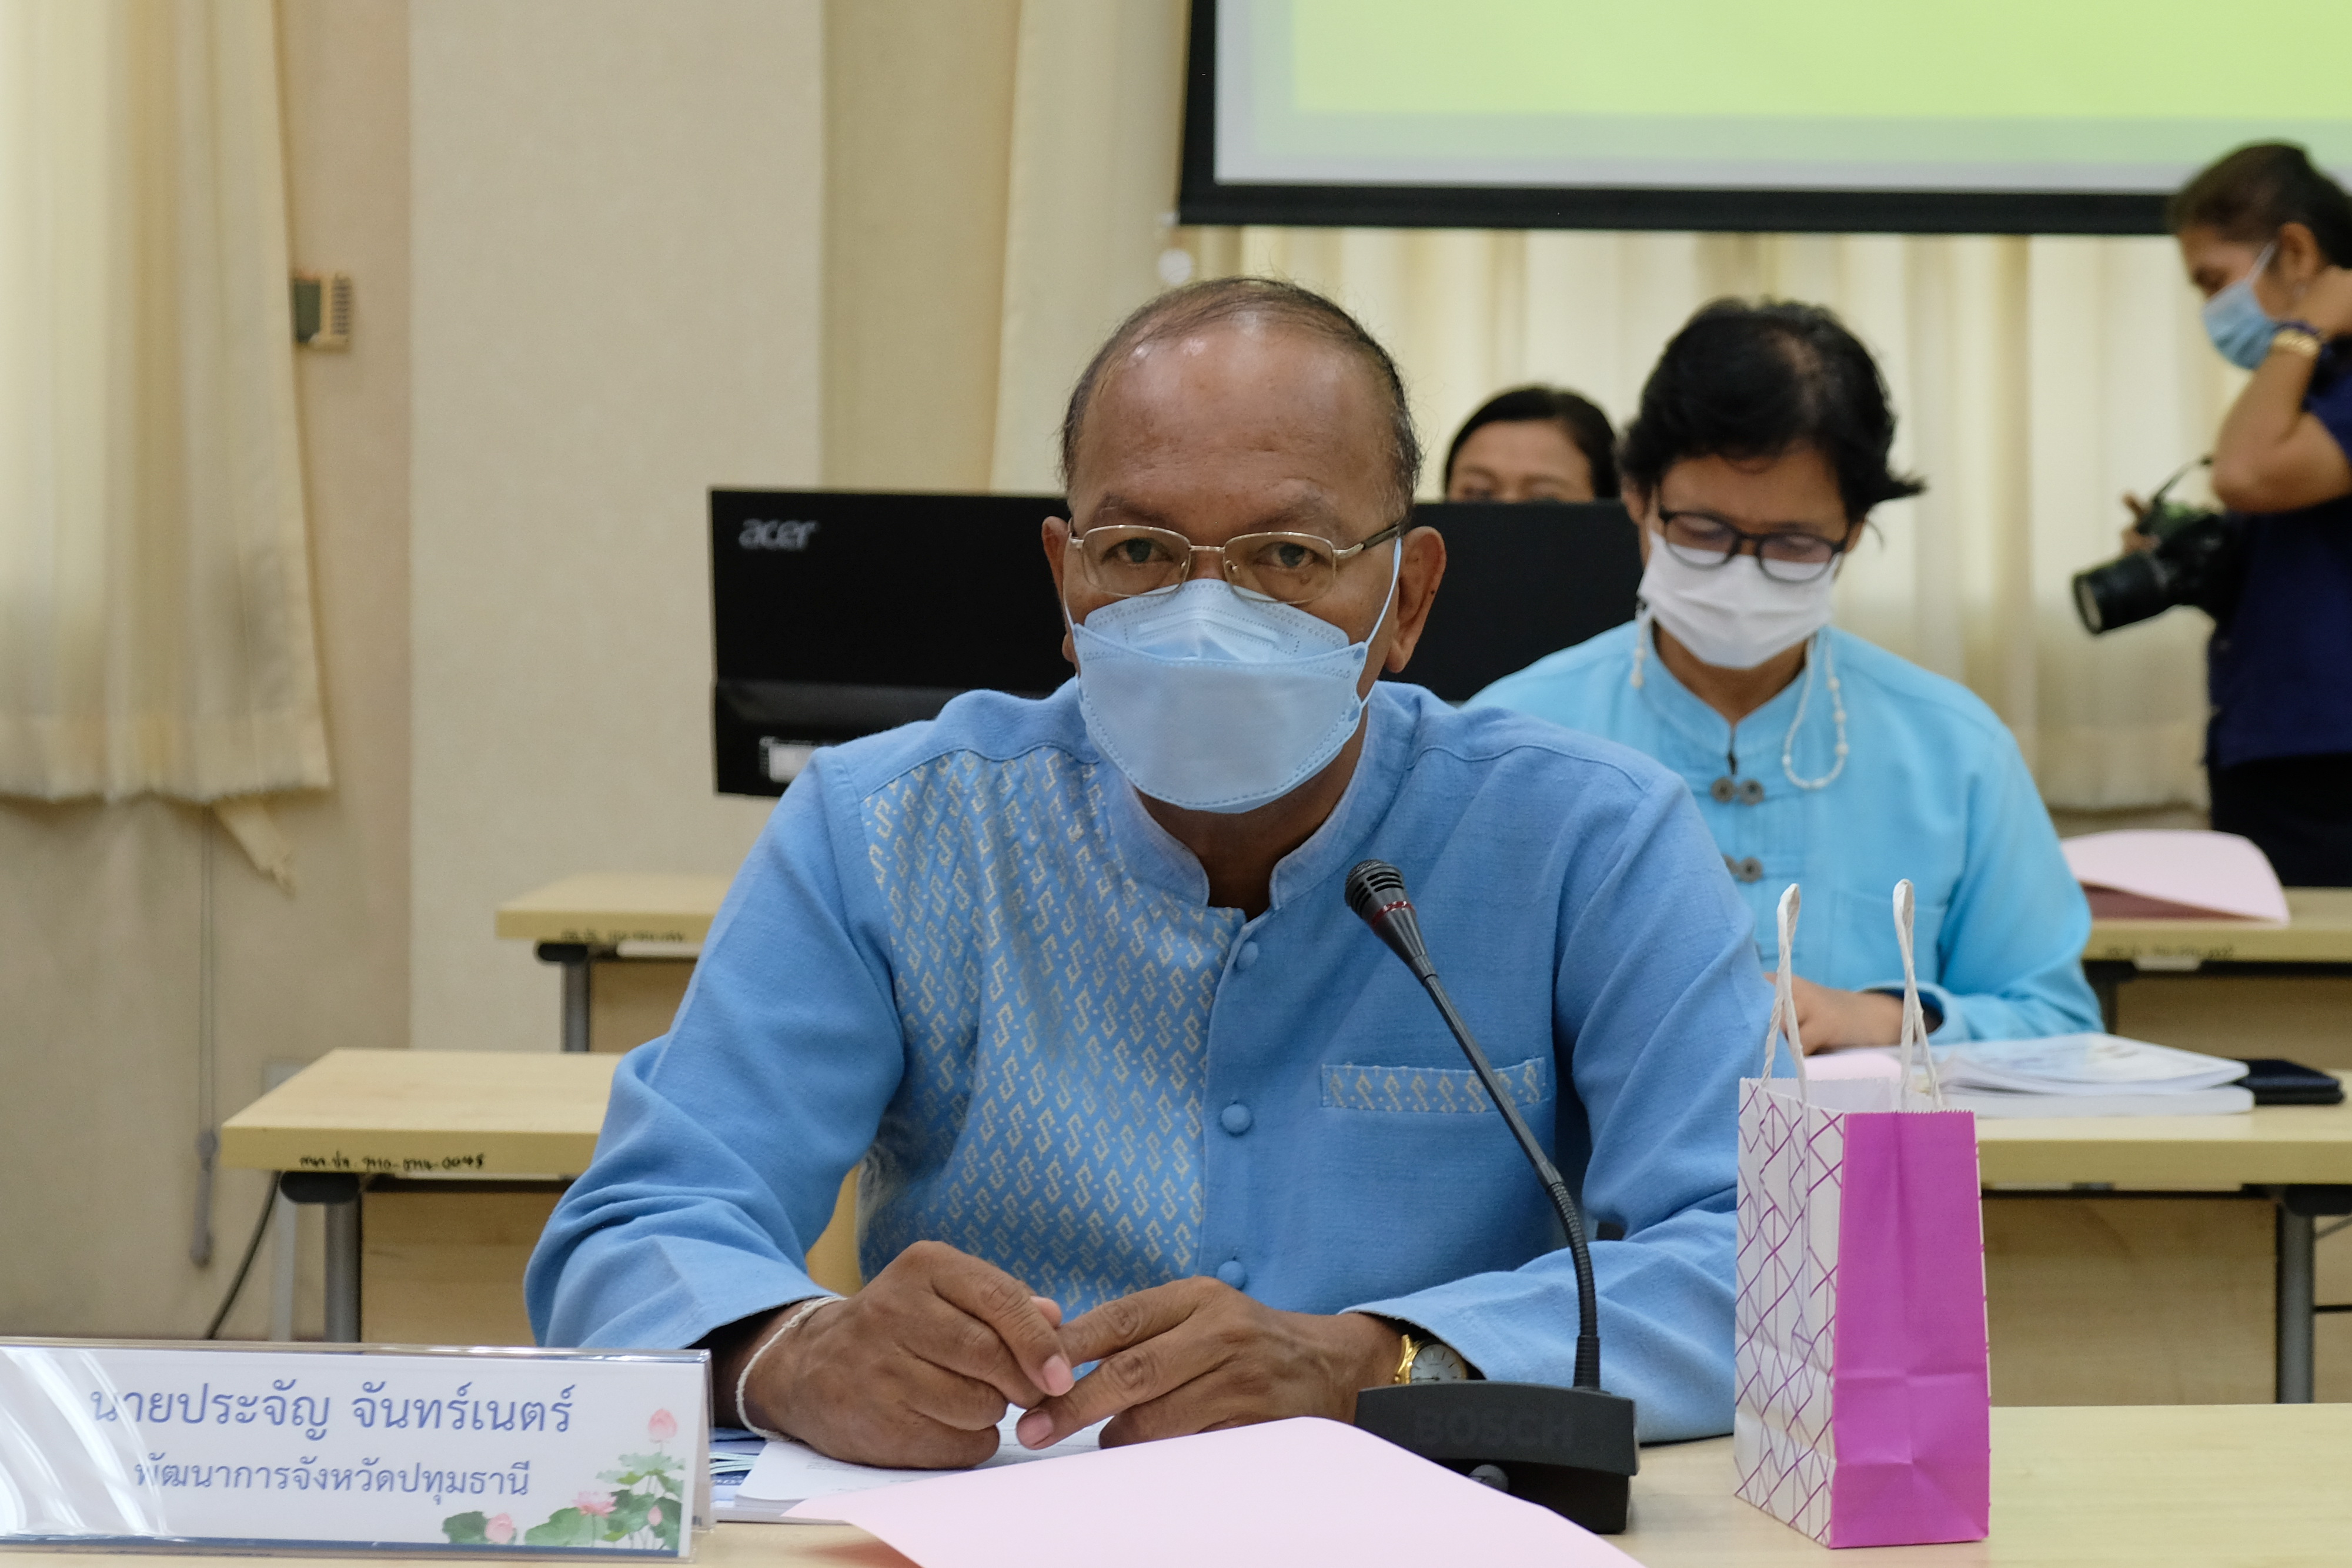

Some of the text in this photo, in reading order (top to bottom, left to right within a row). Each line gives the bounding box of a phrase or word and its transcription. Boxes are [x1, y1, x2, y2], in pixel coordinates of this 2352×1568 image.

[739, 518, 818, 550] acer
[90, 1379, 576, 1441] นายประจัญ จันทร์เนตร์
[134, 1452, 530, 1505] พัฒนาการจังหวัดปทุมธานี
